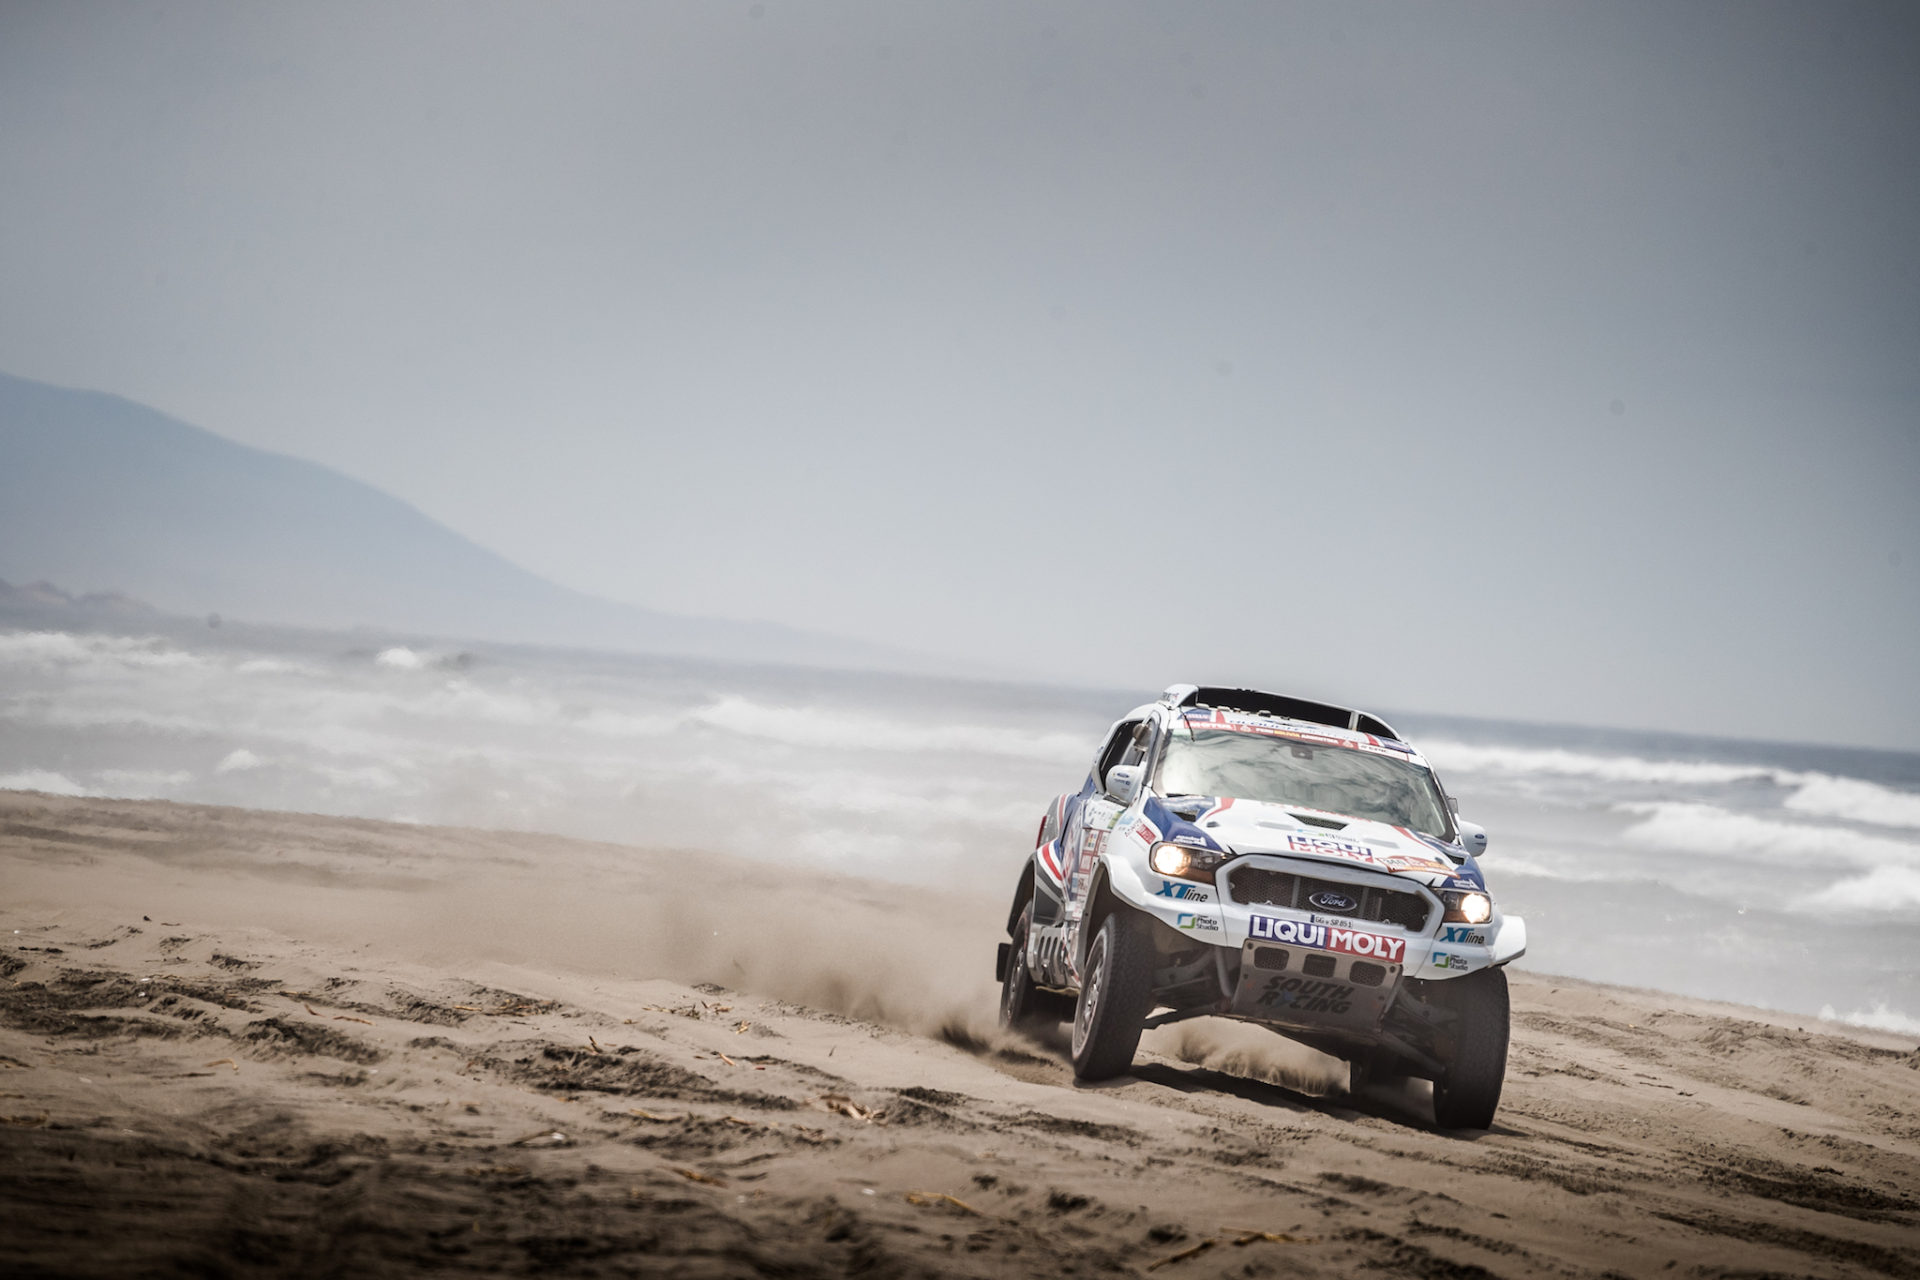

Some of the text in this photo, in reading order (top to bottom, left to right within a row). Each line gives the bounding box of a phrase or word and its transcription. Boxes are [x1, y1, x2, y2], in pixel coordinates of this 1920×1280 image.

[1155, 880, 1208, 903] XTline
[1320, 892, 1347, 908] Ford
[1196, 916, 1218, 926] Photo
[1196, 923, 1219, 932] Studio
[1252, 916, 1404, 960] LIQUI MOLY
[1439, 926, 1485, 945] XTline
[1262, 975, 1355, 1000] SOUTH
